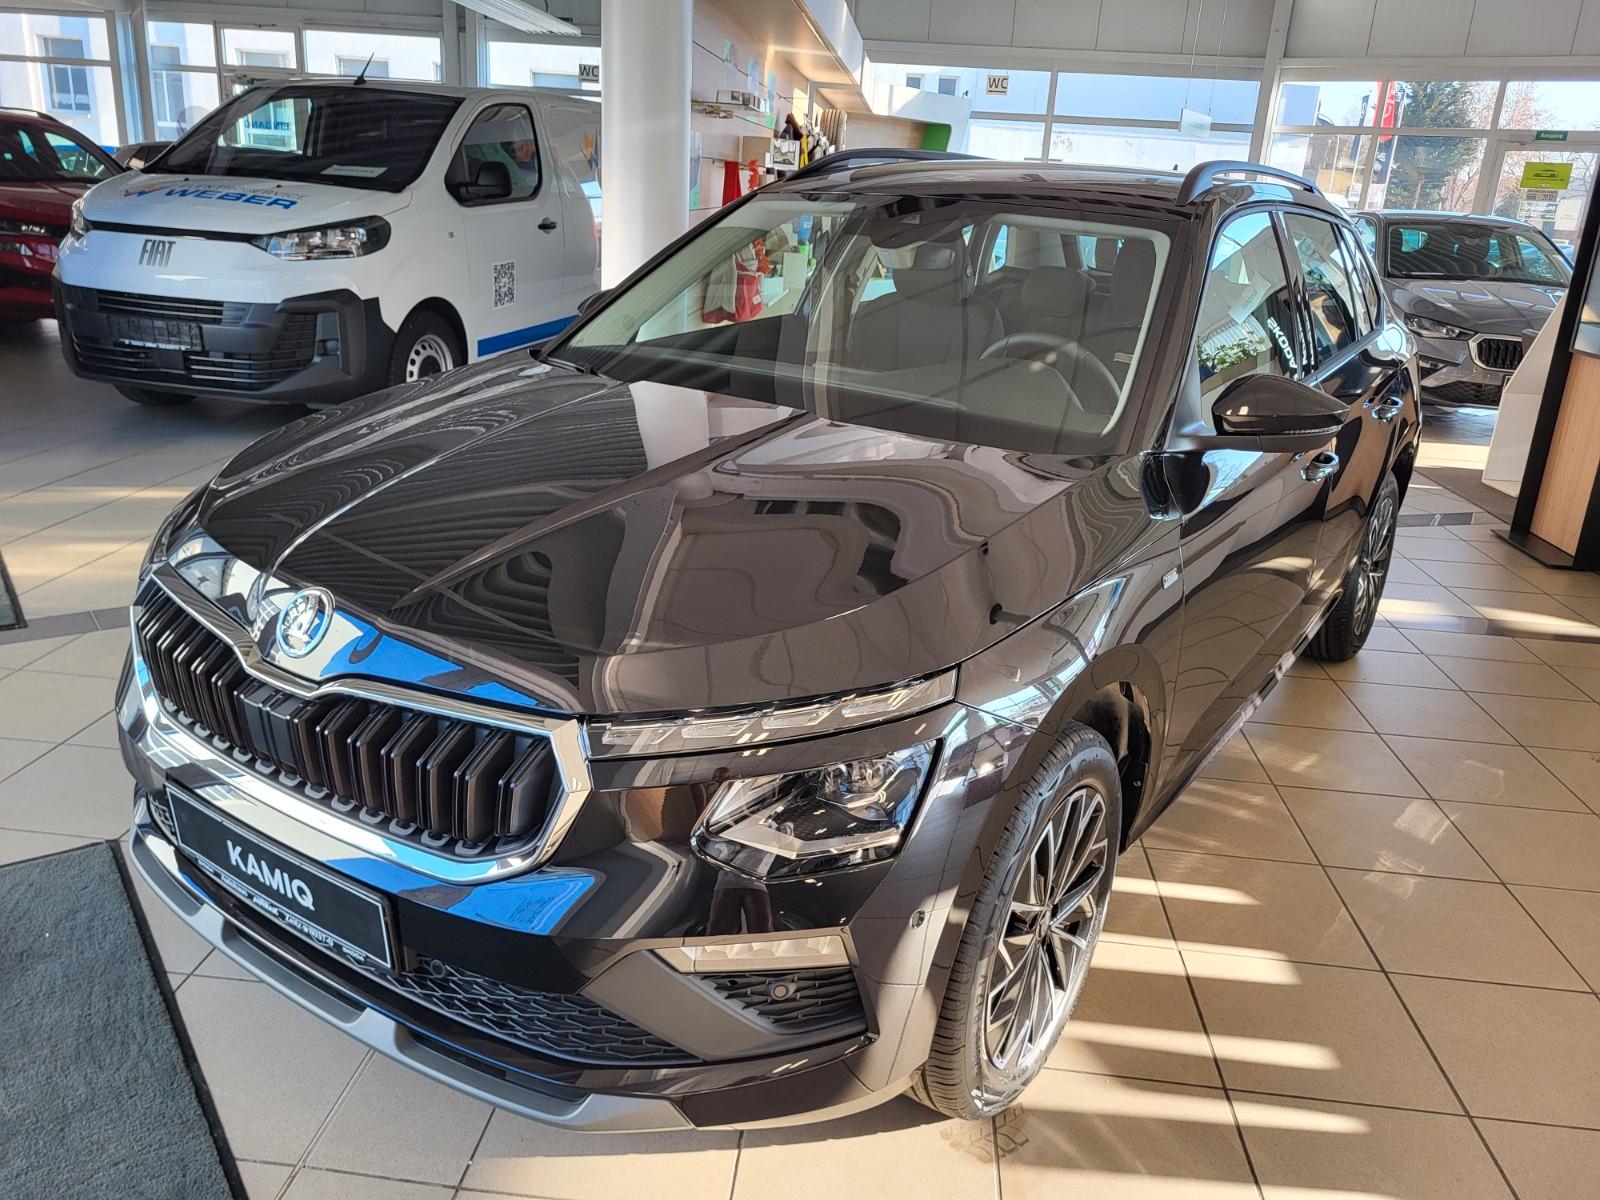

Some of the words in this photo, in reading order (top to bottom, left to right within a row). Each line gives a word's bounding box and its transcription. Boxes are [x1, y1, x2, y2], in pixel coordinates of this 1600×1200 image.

[579, 65, 600, 78] WC
[988, 77, 1009, 90] WC
[165, 187, 298, 210] WEBER
[138, 238, 177, 268] FIAT
[226, 839, 315, 912] KAMIQ
